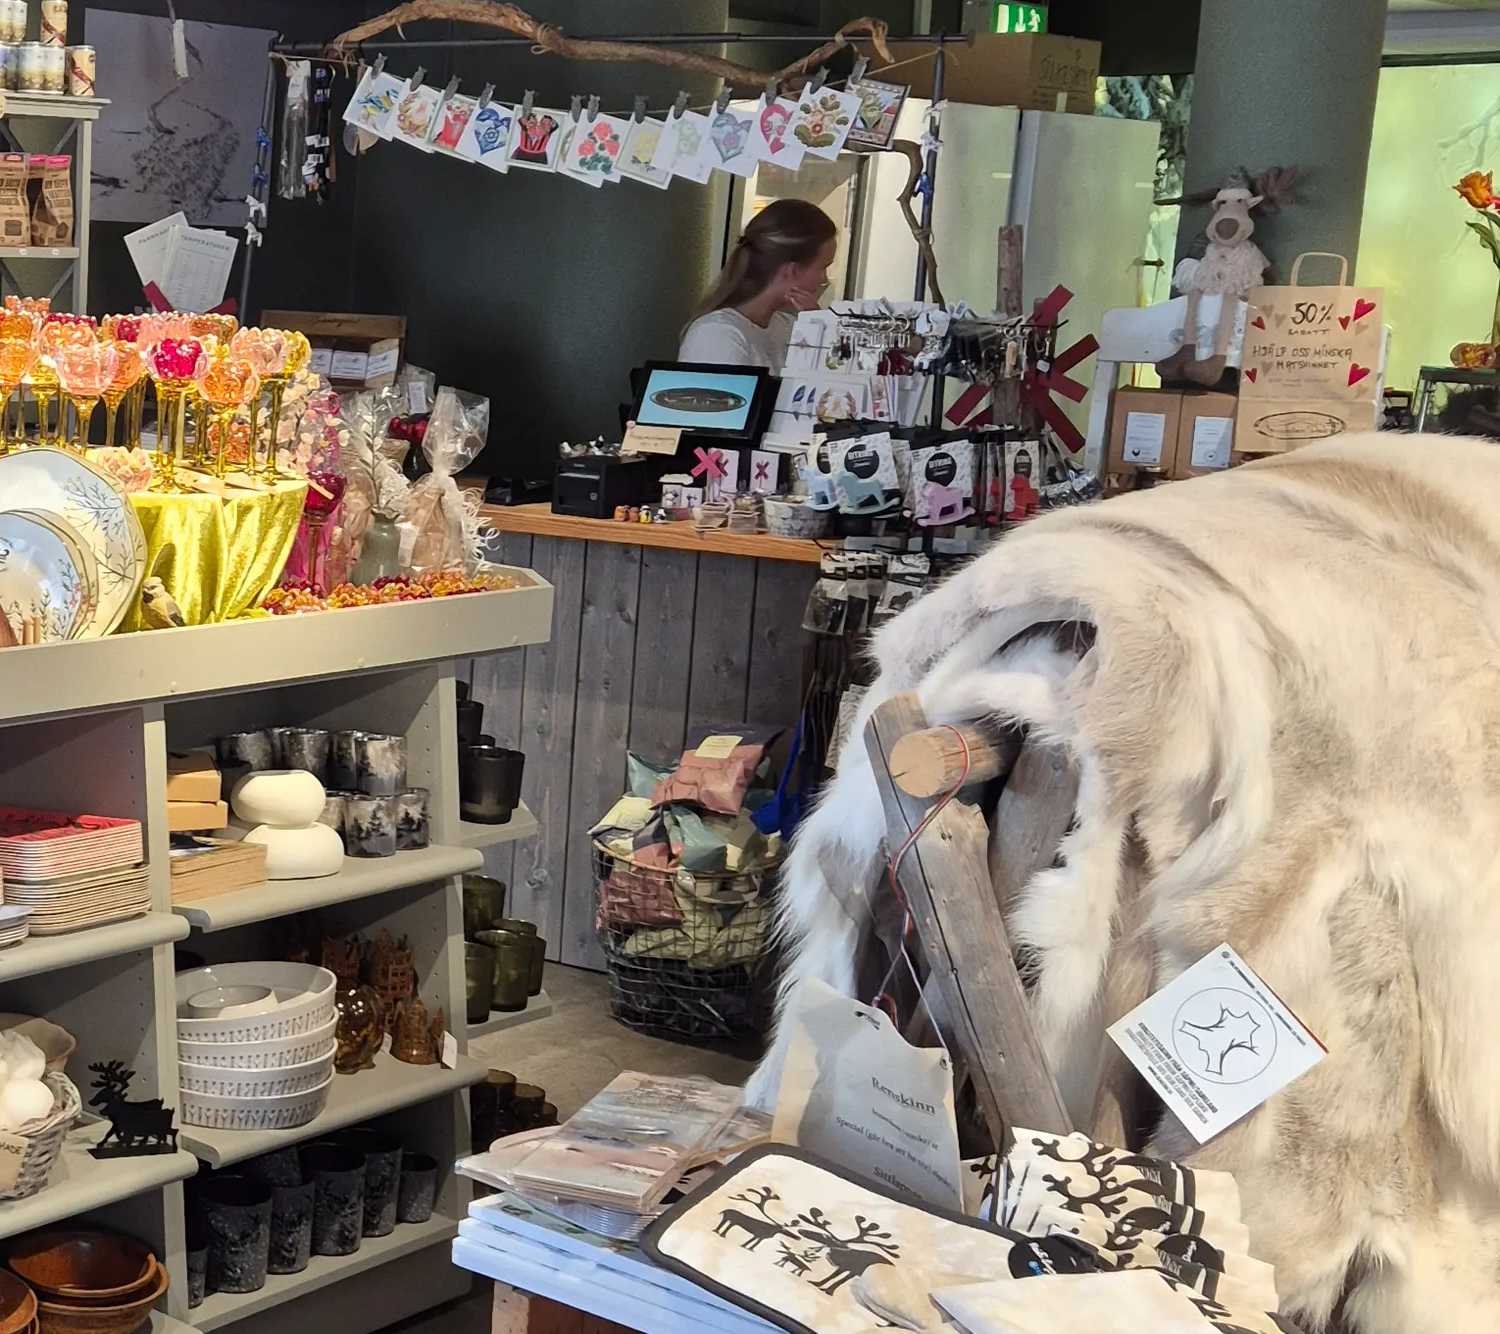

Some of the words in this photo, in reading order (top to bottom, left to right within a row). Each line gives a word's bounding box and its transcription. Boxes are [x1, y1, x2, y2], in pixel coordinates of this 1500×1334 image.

[1290, 302, 1334, 325] 50%
[1253, 344, 1287, 358] HJÄLP
[1292, 346, 1310, 357] OSS
[872, 1076, 935, 1114] Renskinn
[835, 1116, 864, 1134] Special
[865, 1129, 881, 1142] (går
[882, 1137, 894, 1150] bra
[895, 1145, 906, 1157] att
